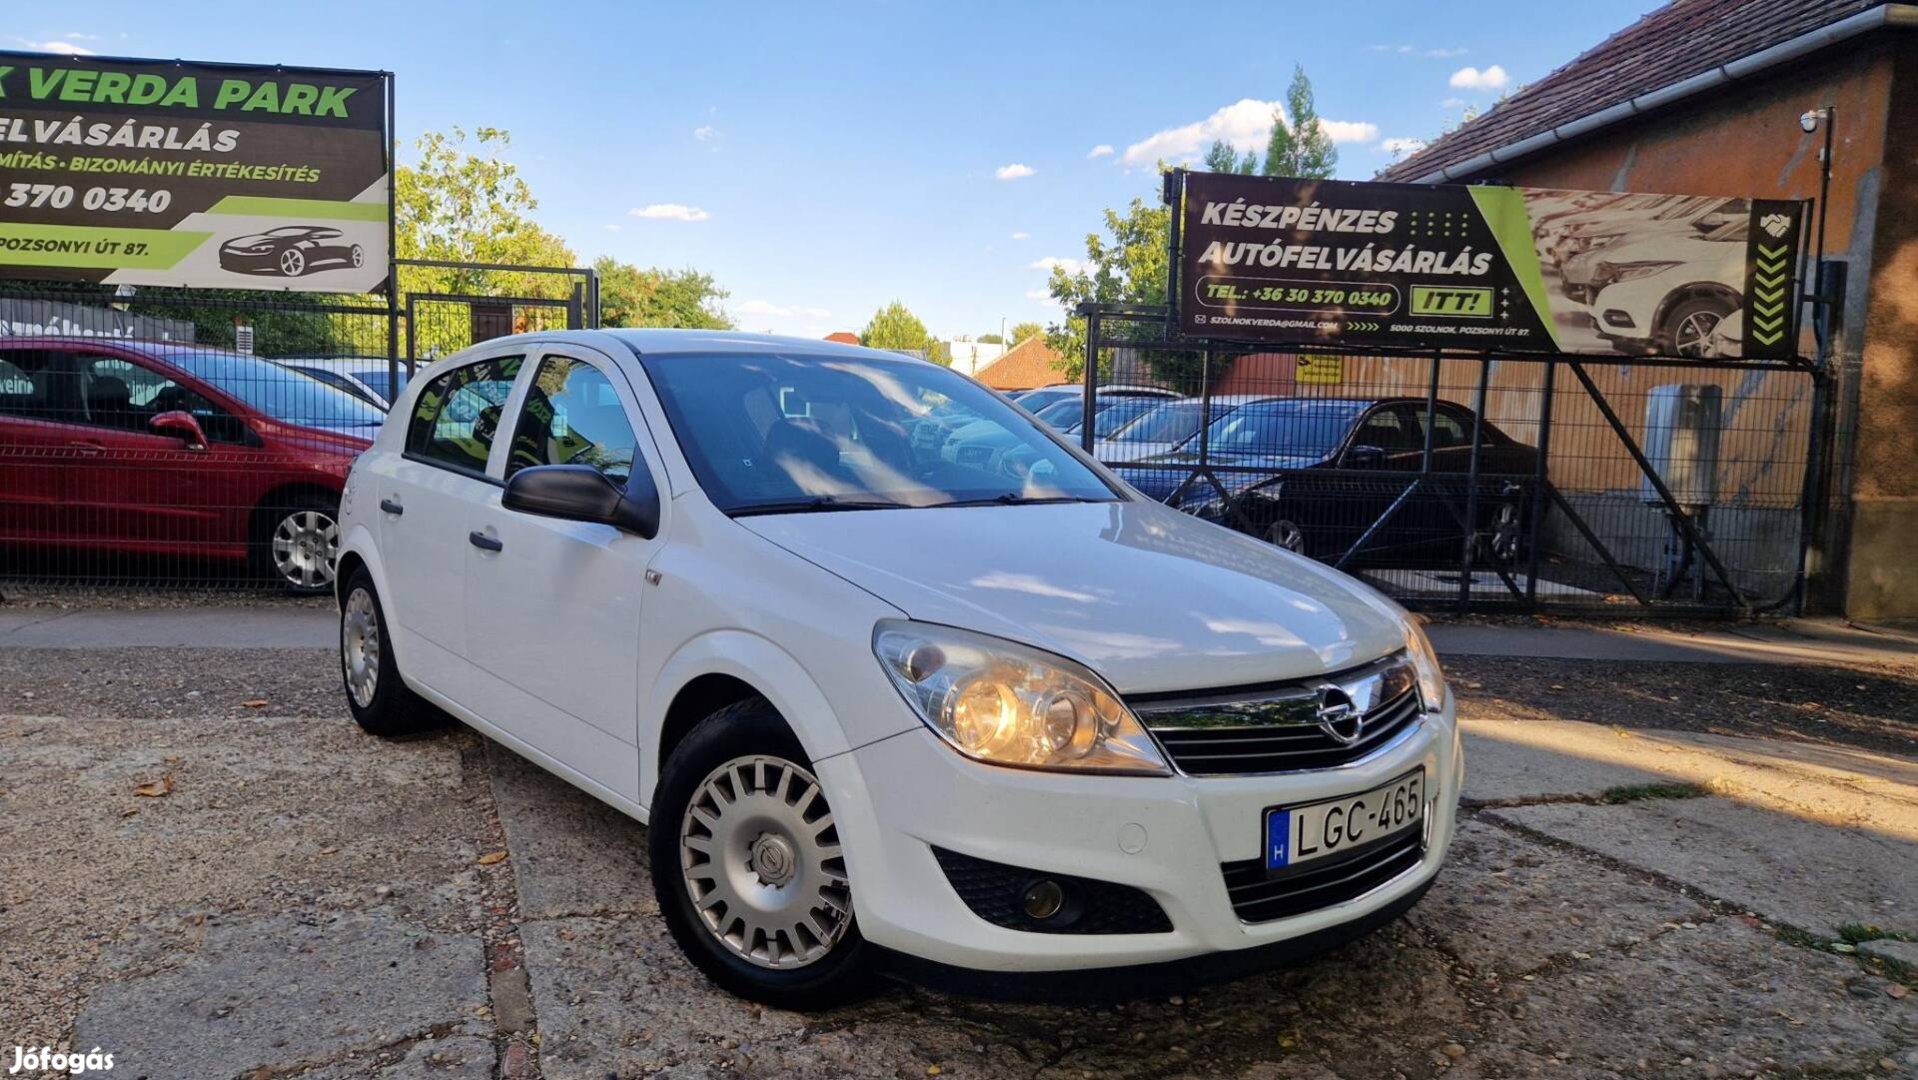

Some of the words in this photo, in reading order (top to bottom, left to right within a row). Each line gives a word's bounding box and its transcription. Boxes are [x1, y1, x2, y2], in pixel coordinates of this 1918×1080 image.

[29, 67, 198, 108] VERDA
[213, 79, 357, 117] PARK
[69, 156, 185, 176] BIZOMÁNYI
[187, 160, 320, 183] ÉRTÉKESÍTÉS
[4, 183, 74, 209] 370
[83, 187, 171, 213] 0340
[1200, 197, 1398, 234] KÉSZPÉNZES
[95, 239, 121, 254] ÚT
[123, 243, 149, 256] 87.
[1198, 239, 1493, 276] AUTÓFELVÁSÁRLÁS
[1207, 284, 1249, 299] TEL.:
[1253, 287, 1283, 301] +36
[1286, 289, 1309, 303] 30
[1312, 290, 1345, 304] 370
[1348, 291, 1391, 305] 0340
[1422, 291, 1480, 311] ITT!
[1210, 316, 1338, 329] SZOLNOKVERDA@GMAIL.COM
[1298, 780, 1418, 857] LGC-465
[1274, 844, 1285, 860] H
